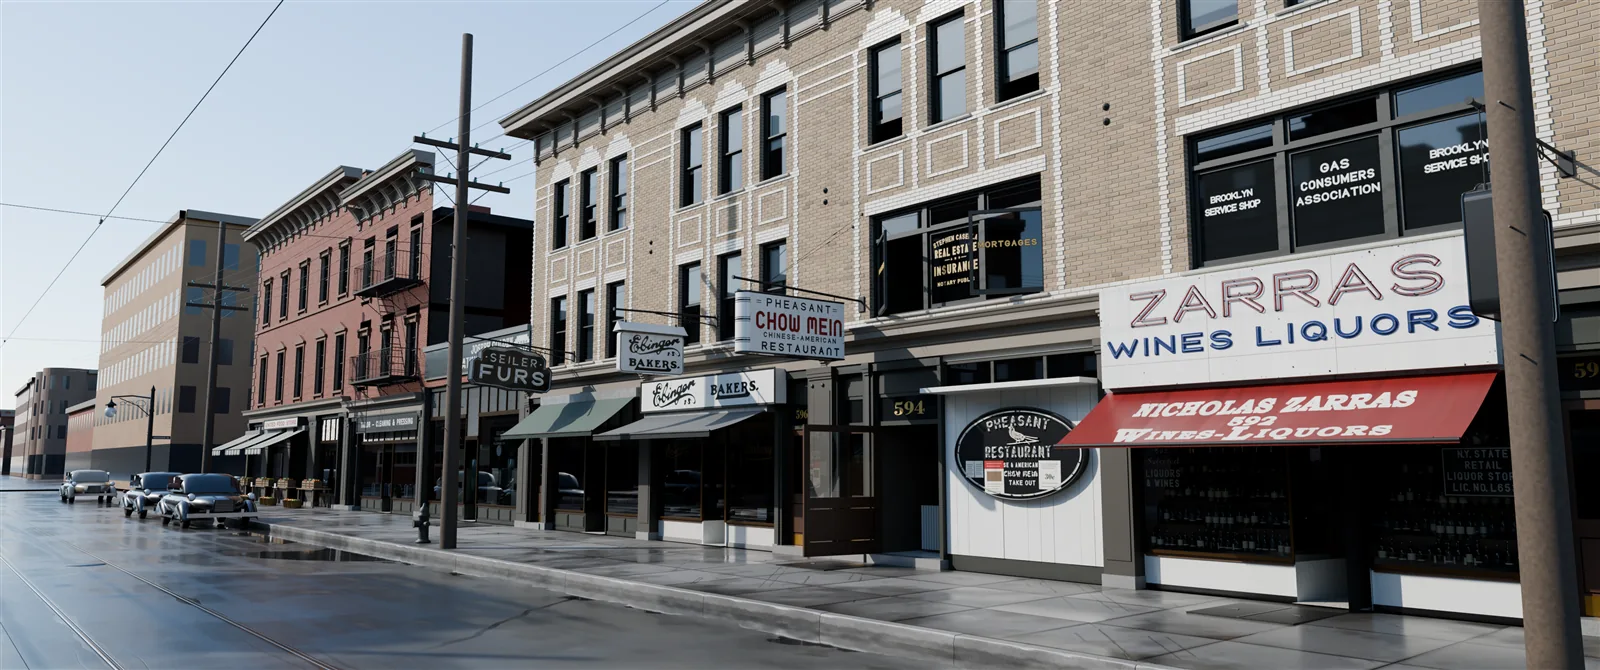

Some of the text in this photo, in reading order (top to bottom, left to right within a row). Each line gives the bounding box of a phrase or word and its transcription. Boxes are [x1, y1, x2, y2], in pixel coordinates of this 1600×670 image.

[1429, 139, 1488, 160] BROOKLYN
[1320, 158, 1350, 173] GAS
[1424, 152, 1489, 174] SERVICE SHO
[1300, 168, 1375, 192] CONSUMERS
[1210, 188, 1253, 204] BROOKLYN
[1296, 182, 1381, 207] ASSOCIATION
[1205, 199, 1261, 217] SERVICE SHOP
[933, 235, 954, 248] STEPHEN
[978, 238, 1037, 248] MORTGAGES
[934, 242, 977, 259] REAL ESTAE
[1130, 252, 1445, 328] ZARRAS
[766, 298, 831, 314] PHEASANT
[756, 311, 842, 337] CHOW MEIN
[1107, 305, 1480, 359] WINES LIQUORS
[763, 332, 837, 344] CHINESE-AMERICAN
[762, 341, 839, 356] RESTAURANT
[490, 353, 537, 368] SEILER
[629, 358, 680, 372] BAKERS.
[479, 363, 544, 387] FURS
[1574, 362, 1600, 378] 59
[711, 380, 759, 400] BAKERS.
[894, 400, 925, 416] 594
[1132, 390, 1418, 418] NICHOLAS ZARRAS
[396, 418, 413, 426] PRESSING
[796, 410, 808, 419] 596
[1227, 416, 1277, 427] 592
[986, 415, 1050, 431] PHEASANT
[1113, 424, 1393, 444] WINES-LIQUORS
[985, 445, 1051, 459] RESTAURANT
[1474, 449, 1508, 459] STATE
[1145, 469, 1181, 478] LIQUORS
[1464, 461, 1502, 470] RETAIL
[1154, 479, 1180, 488] WINES
[1447, 472, 1513, 481] LIQUOR STOR
[1490, 483, 1514, 492] L65
